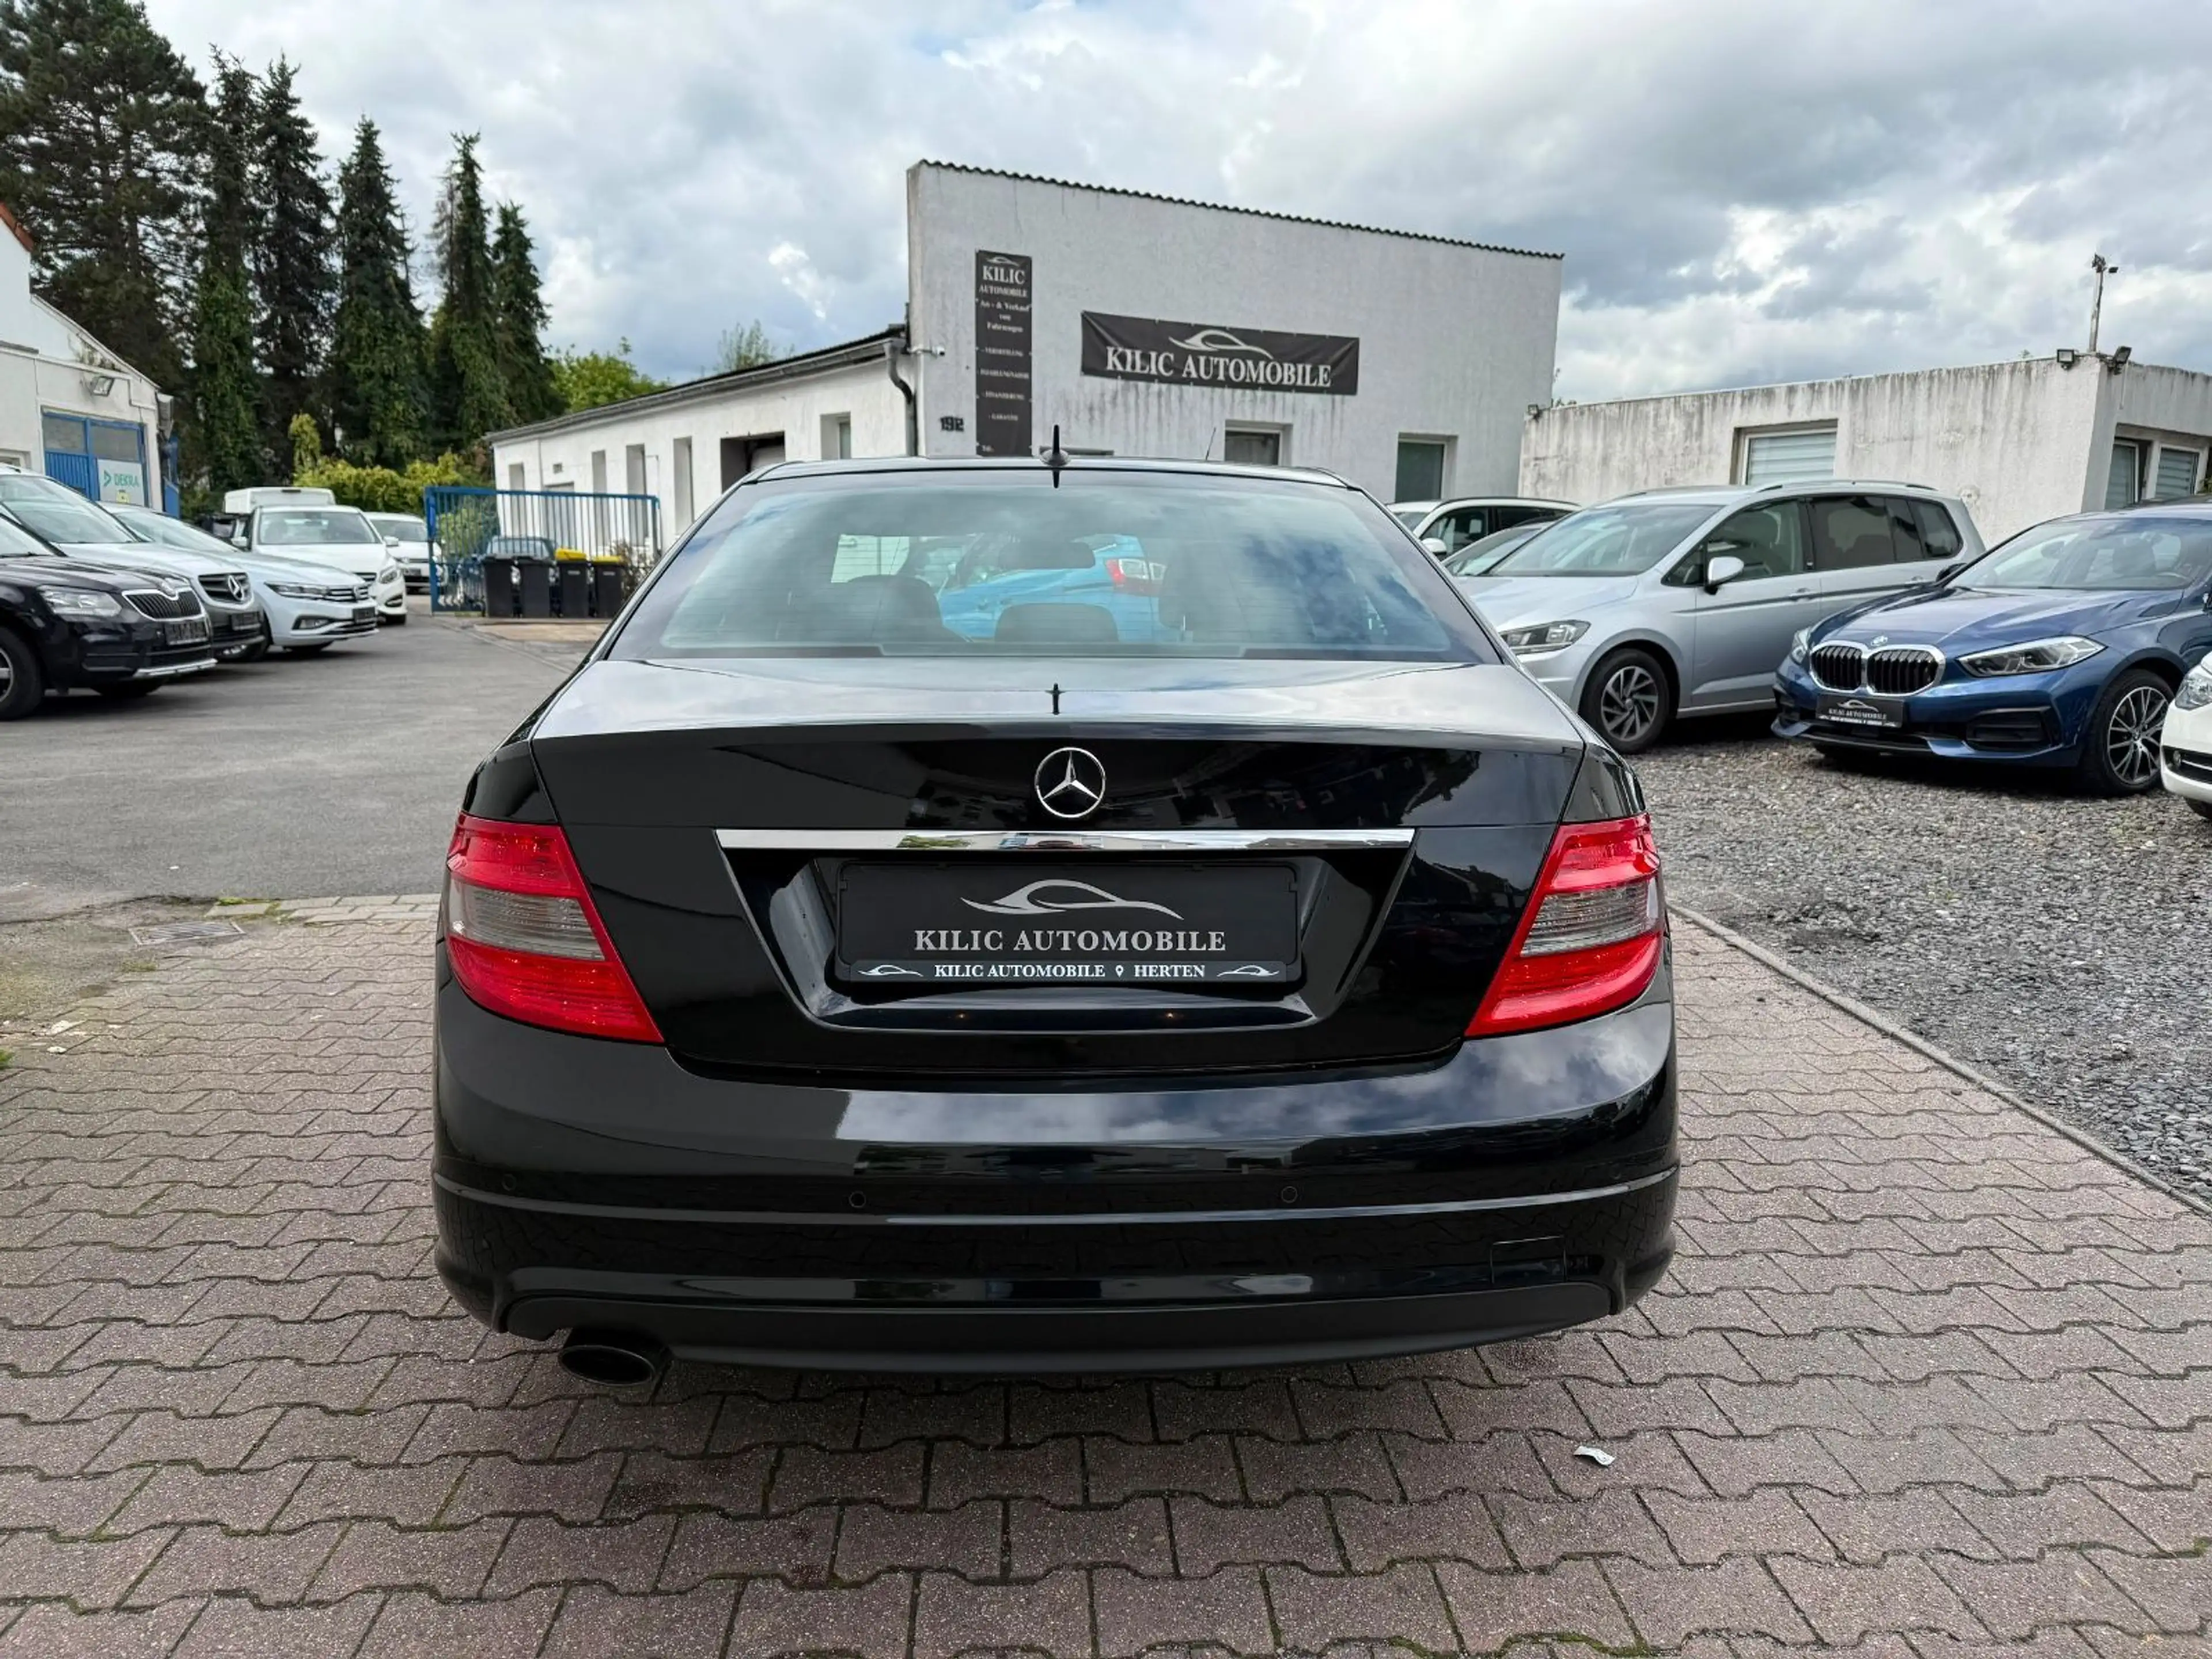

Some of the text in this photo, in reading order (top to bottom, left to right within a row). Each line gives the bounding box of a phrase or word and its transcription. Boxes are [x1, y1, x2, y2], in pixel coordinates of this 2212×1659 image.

[983, 265, 1025, 285] KILIC
[1107, 346, 1332, 387] KILIC AUTOMOBILE
[940, 416, 964, 432] 192
[914, 930, 1226, 951] KILIC AUTOMOBILE
[934, 965, 1205, 978] KILIC AUTOMOBILE HERTEN
